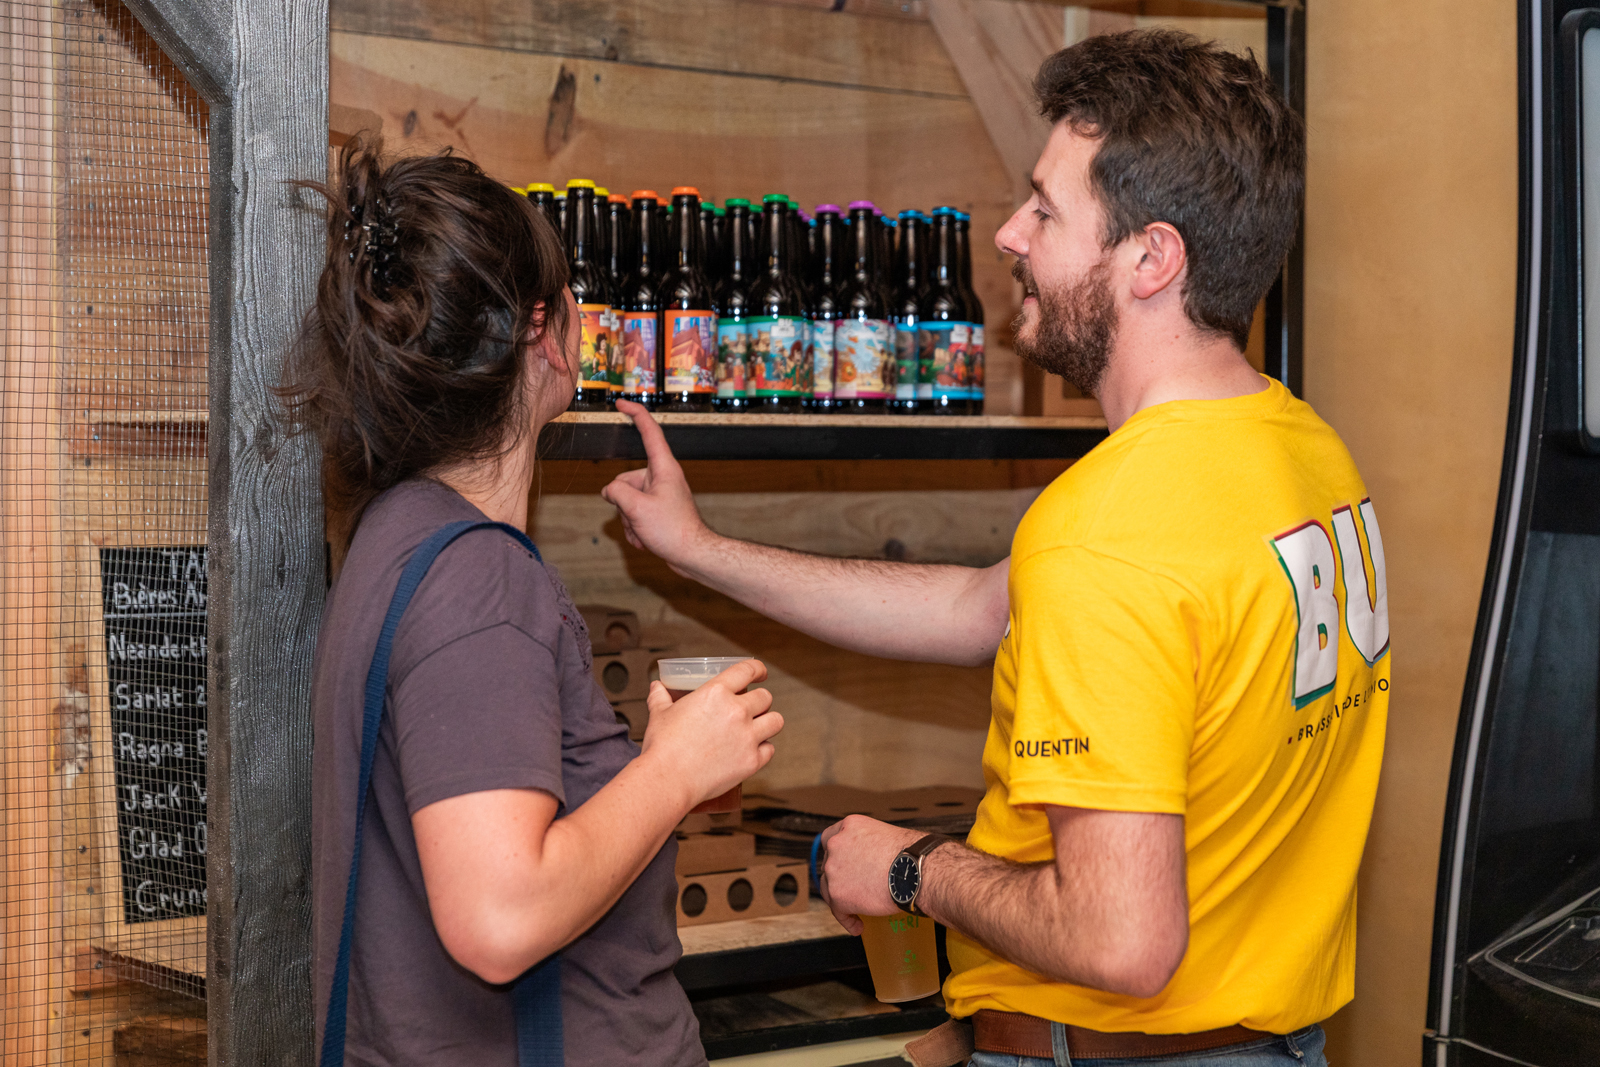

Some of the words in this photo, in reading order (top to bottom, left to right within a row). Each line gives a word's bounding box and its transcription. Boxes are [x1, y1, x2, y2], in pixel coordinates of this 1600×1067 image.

[113, 581, 178, 609] Bières
[116, 683, 183, 710] Sarlat
[118, 731, 183, 766] Ragna
[1014, 737, 1090, 758] QUENTIN
[129, 826, 182, 859] Glad
